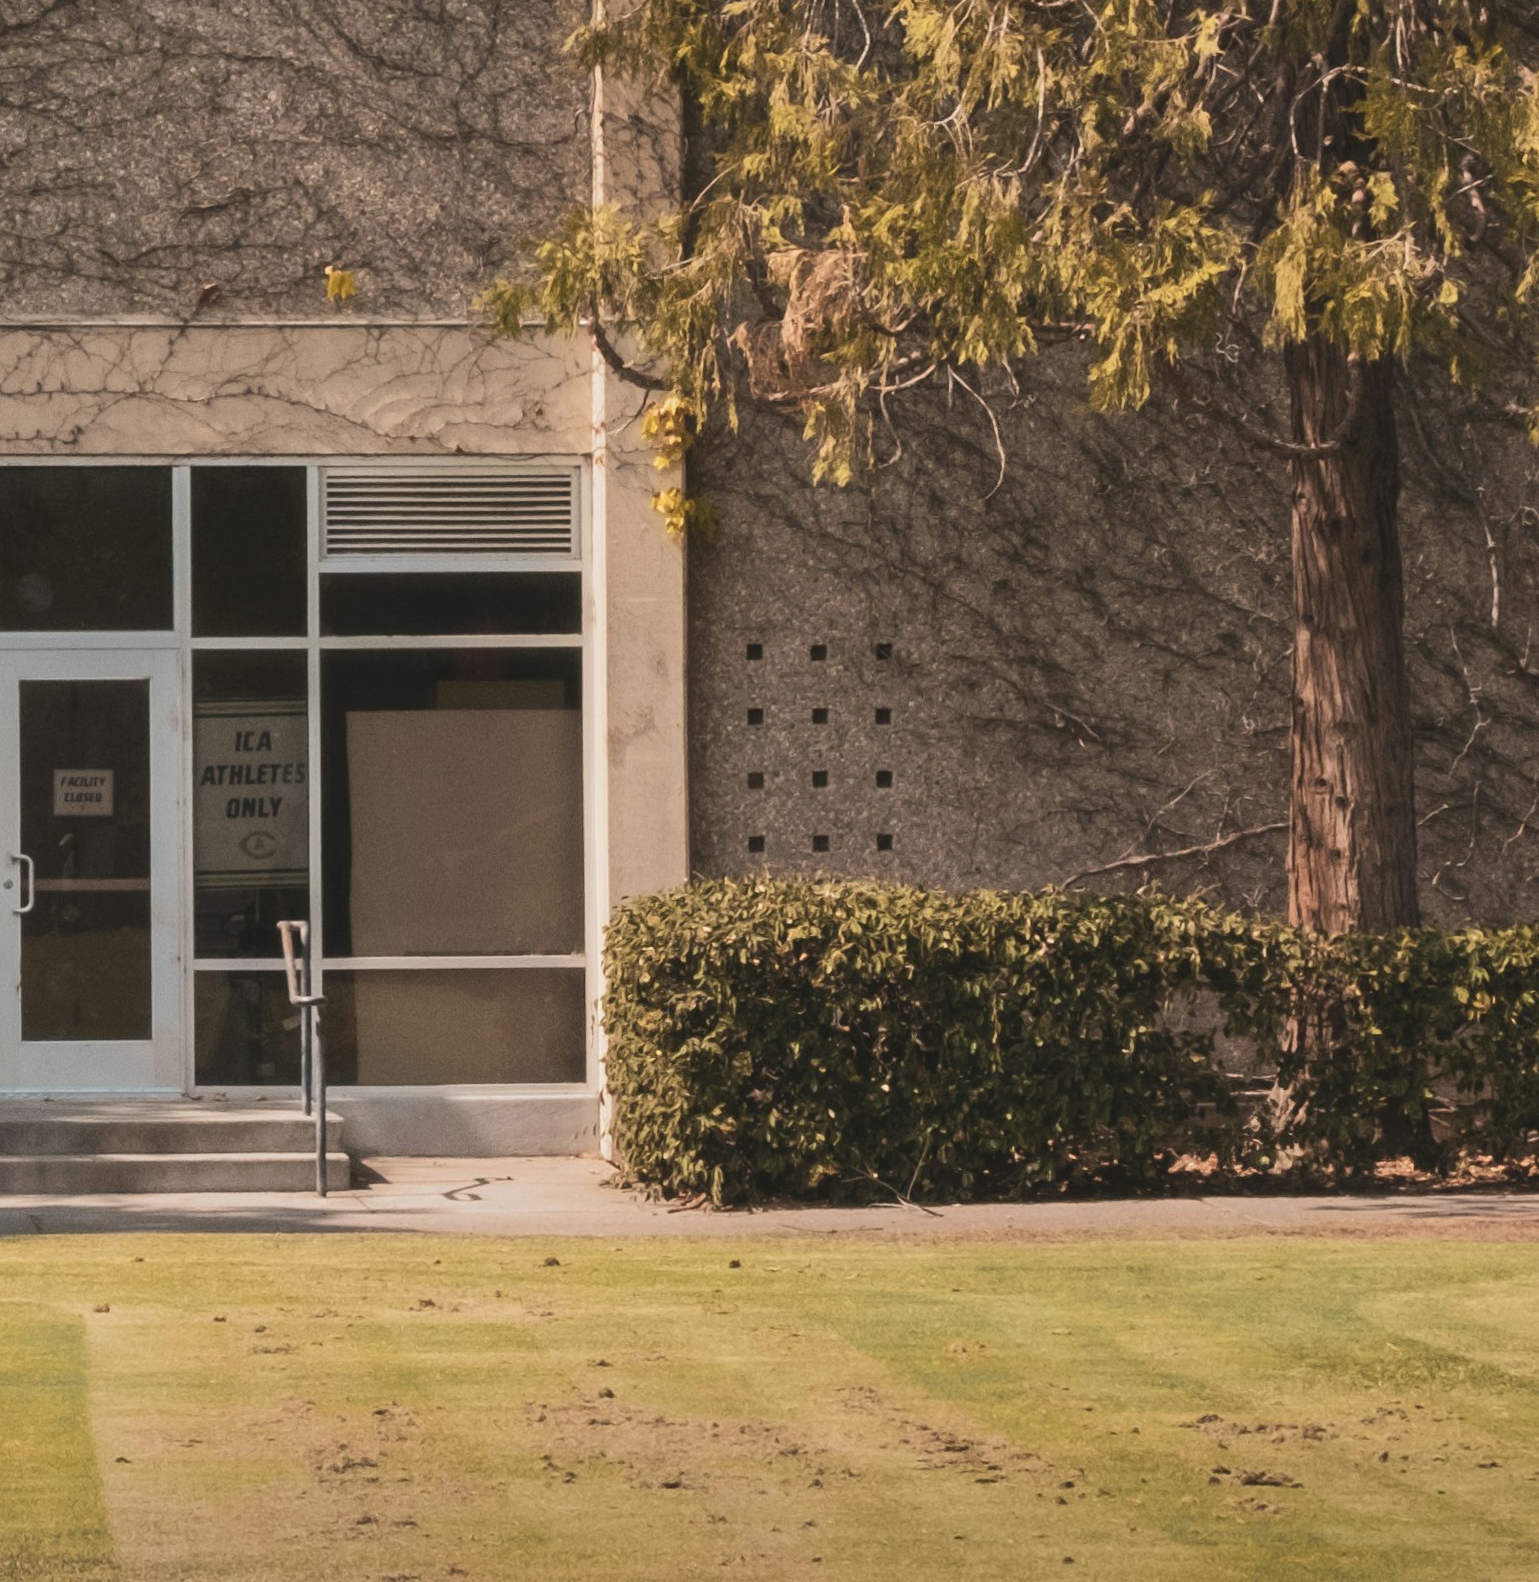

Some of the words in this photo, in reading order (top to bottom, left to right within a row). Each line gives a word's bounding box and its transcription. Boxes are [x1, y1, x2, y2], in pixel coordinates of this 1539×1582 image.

[234, 731, 272, 752] ICA
[60, 776, 106, 788] FACILITY
[200, 762, 306, 786] ATHLETES
[64, 791, 102, 803] CLOSED
[225, 796, 283, 819] ONLY
